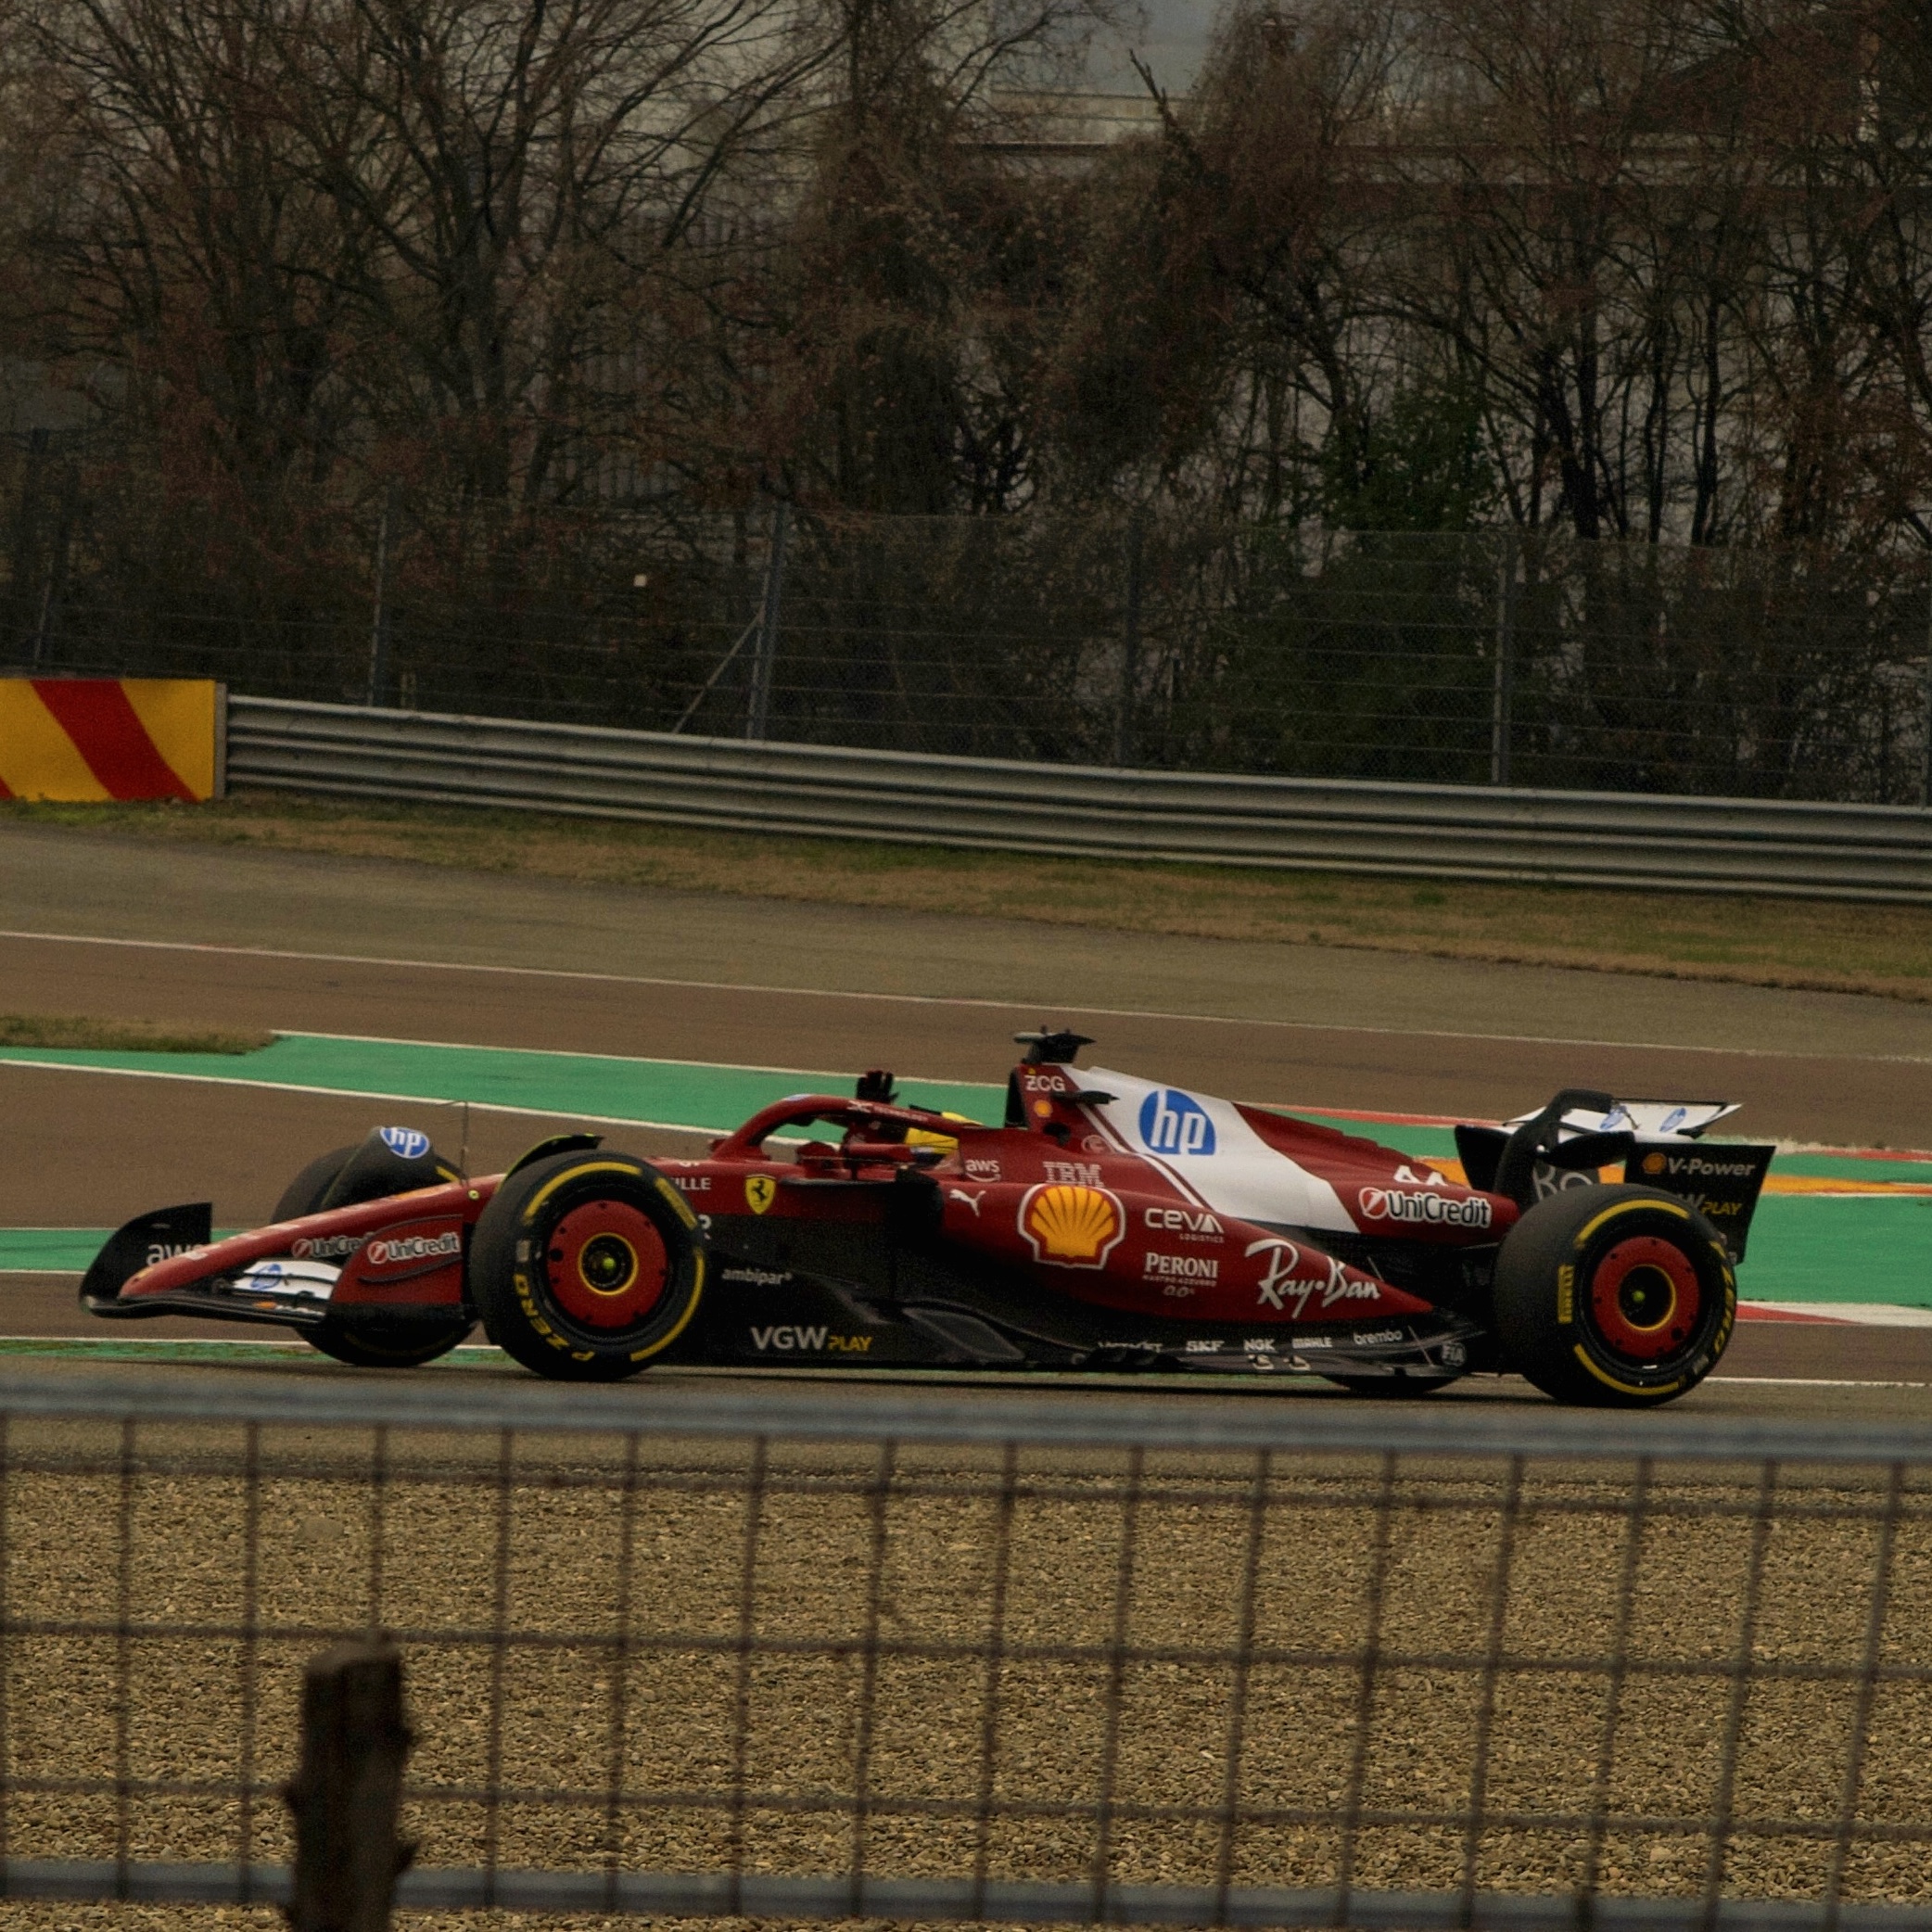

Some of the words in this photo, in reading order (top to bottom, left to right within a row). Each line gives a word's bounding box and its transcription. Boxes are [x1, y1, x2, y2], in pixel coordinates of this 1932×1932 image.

[1144, 1089, 1211, 1155] hp
[385, 1125, 426, 1158] hp
[965, 1159, 1000, 1175] aws
[1669, 1157, 1756, 1176] V-Power
[1387, 1190, 1490, 1227] UniCredit
[388, 1231, 462, 1261] UniCredit
[1144, 1252, 1218, 1278] PERONI
[1353, 1328, 1404, 1345] brembo
